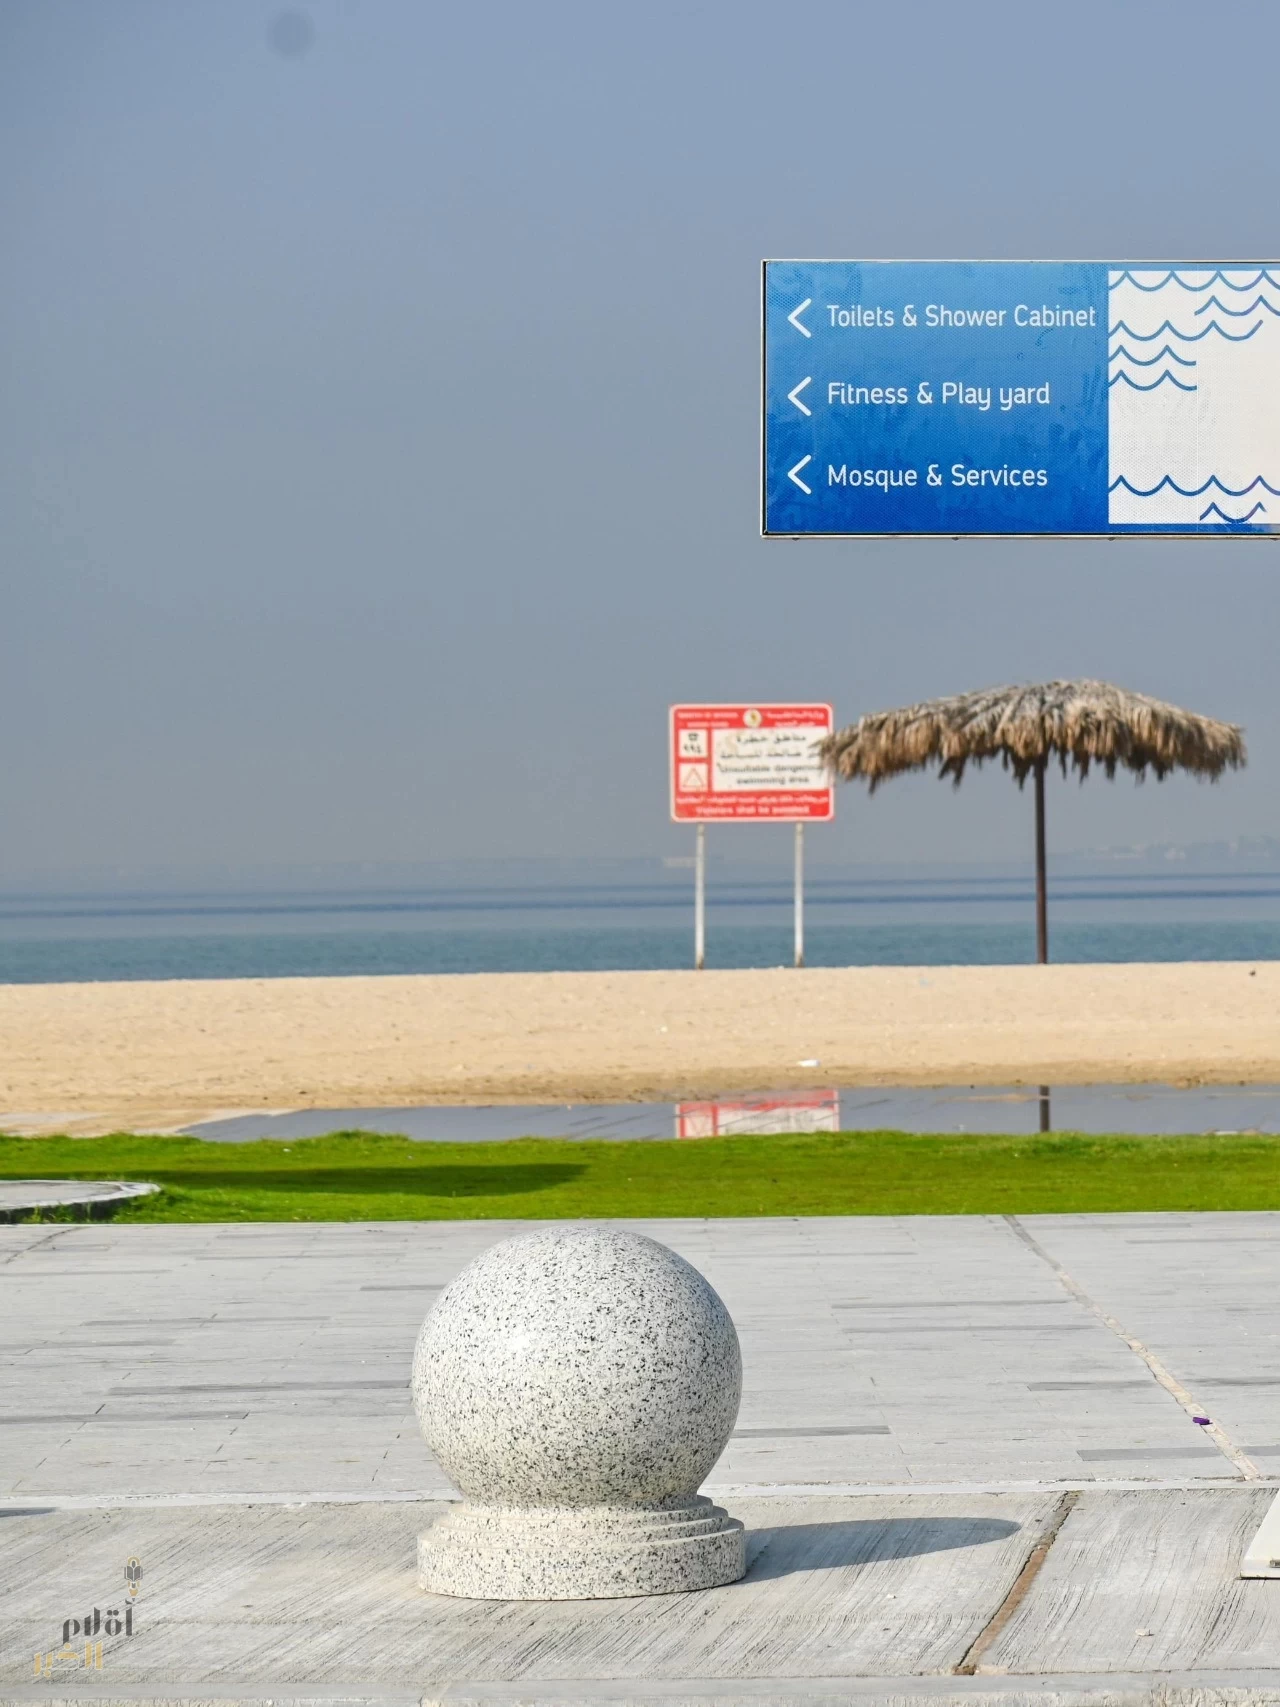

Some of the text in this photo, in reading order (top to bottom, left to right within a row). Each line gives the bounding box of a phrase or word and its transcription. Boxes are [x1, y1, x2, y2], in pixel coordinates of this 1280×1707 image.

[826, 304, 1096, 327] Toilets & Shower Cabinet
[828, 381, 1051, 411] Fitness & Play yard
[828, 463, 1048, 493] Mosque & Services
